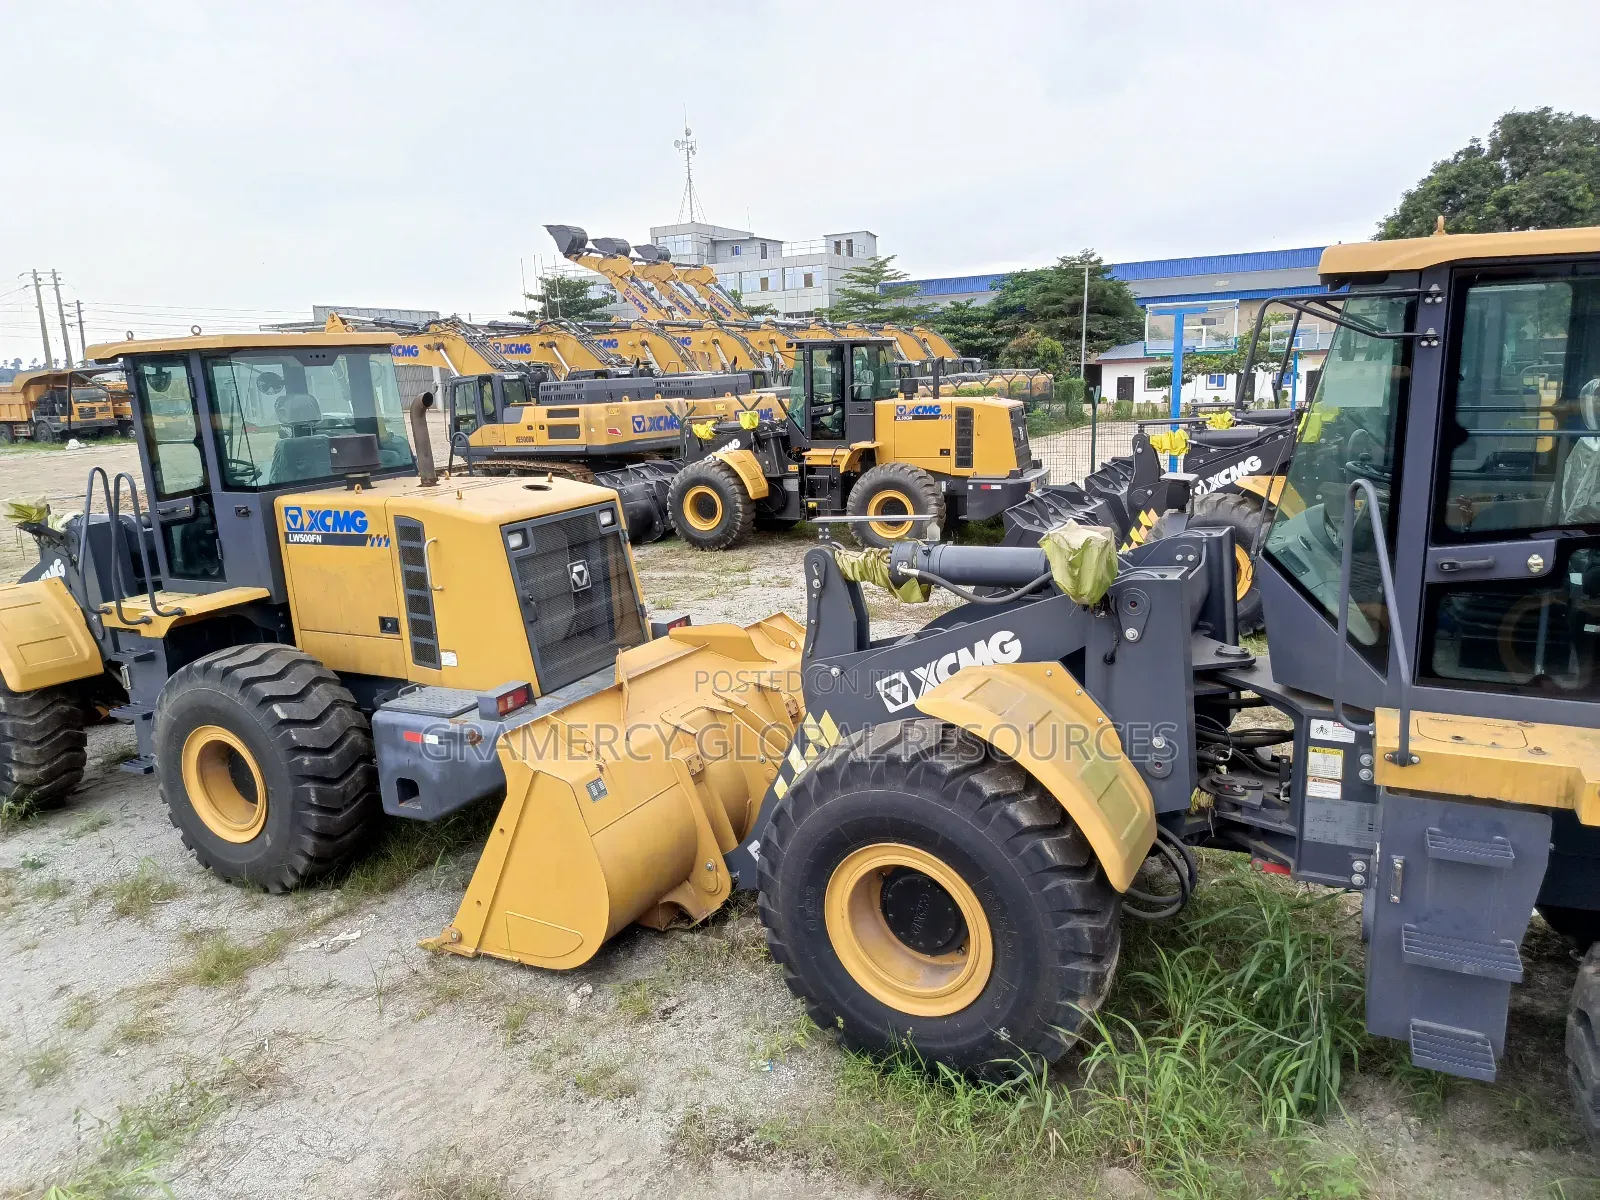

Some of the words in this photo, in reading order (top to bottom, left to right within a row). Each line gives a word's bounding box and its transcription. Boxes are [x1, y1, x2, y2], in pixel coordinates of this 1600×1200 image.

[630, 294, 648, 314] XCMG
[674, 298, 691, 316] XCMG
[714, 301, 731, 317] XCMG
[502, 343, 531, 354] XCMG
[906, 404, 941, 415] XCMG
[1206, 455, 1262, 492] XCMG
[306, 510, 368, 533] XCMG
[289, 533, 321, 543] LW500FN
[910, 630, 1022, 698] XCMG
